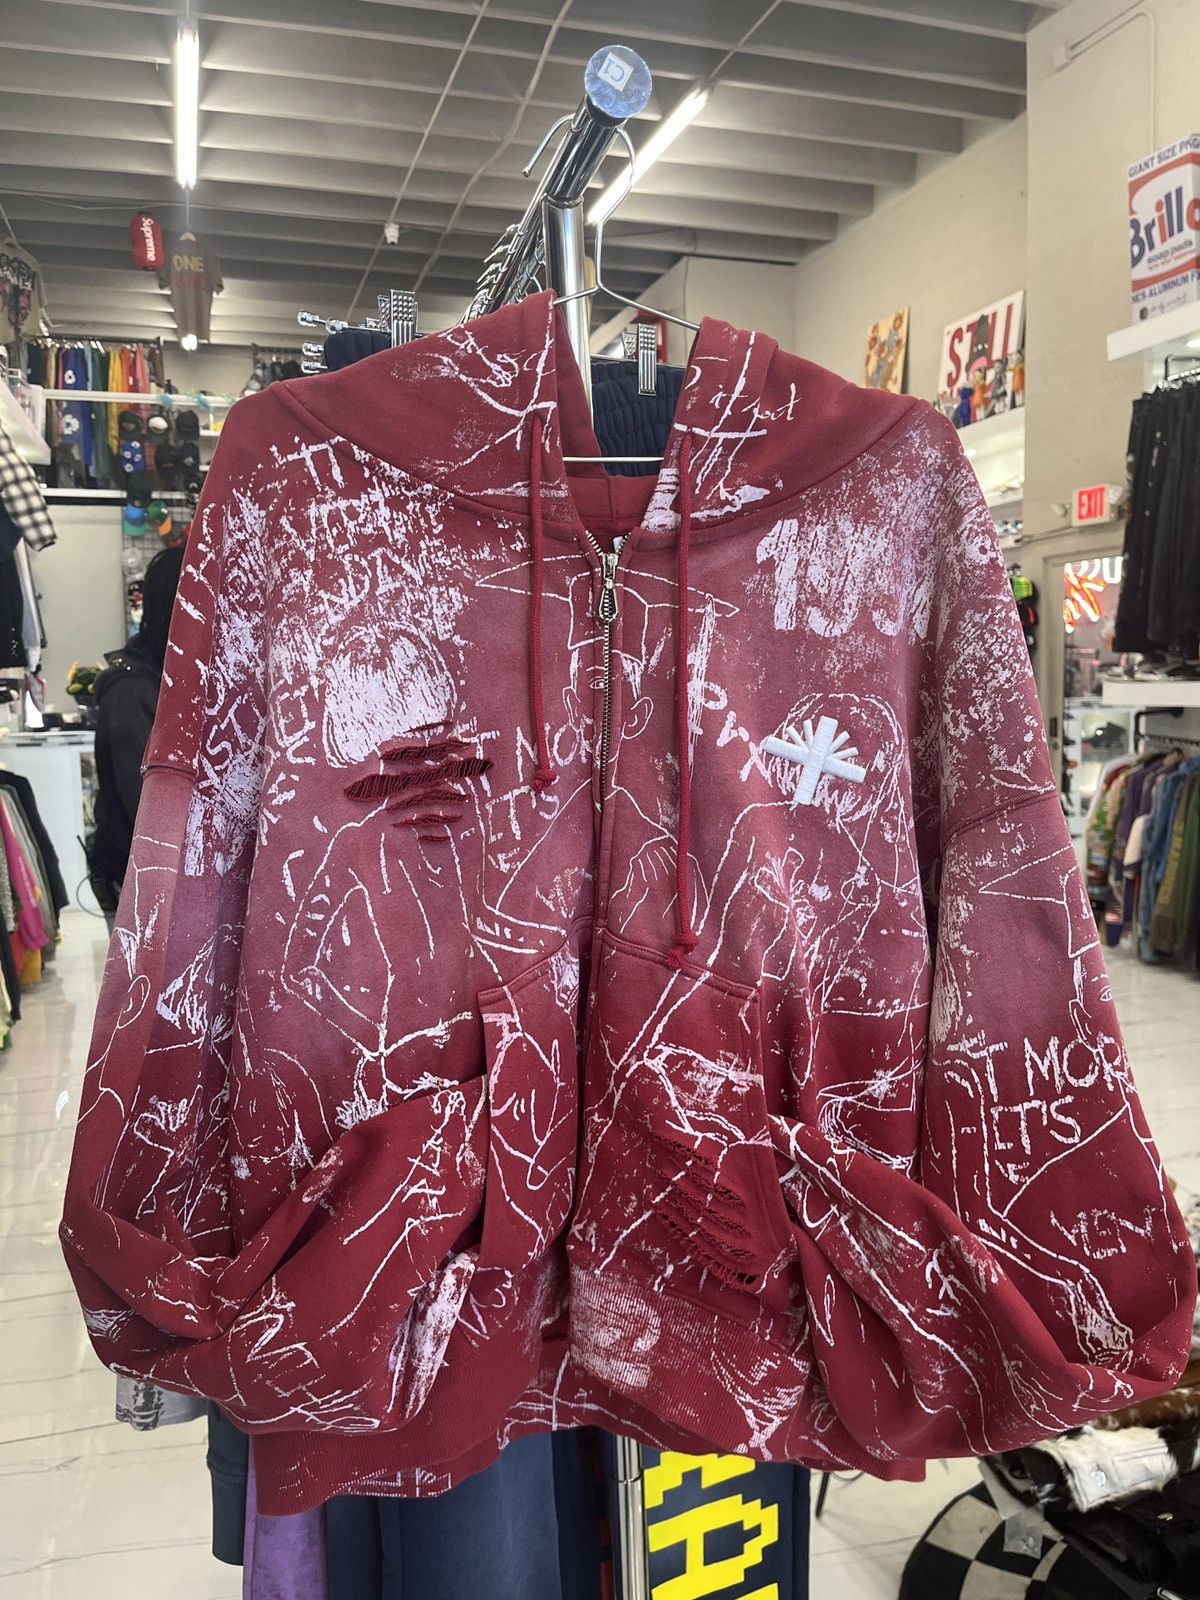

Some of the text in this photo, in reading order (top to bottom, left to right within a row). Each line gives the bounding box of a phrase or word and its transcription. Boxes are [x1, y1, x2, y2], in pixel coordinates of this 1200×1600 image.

[140, 216, 156, 261] Supreme
[172, 253, 204, 273] ONE
[1078, 486, 1106, 521] EXIT
